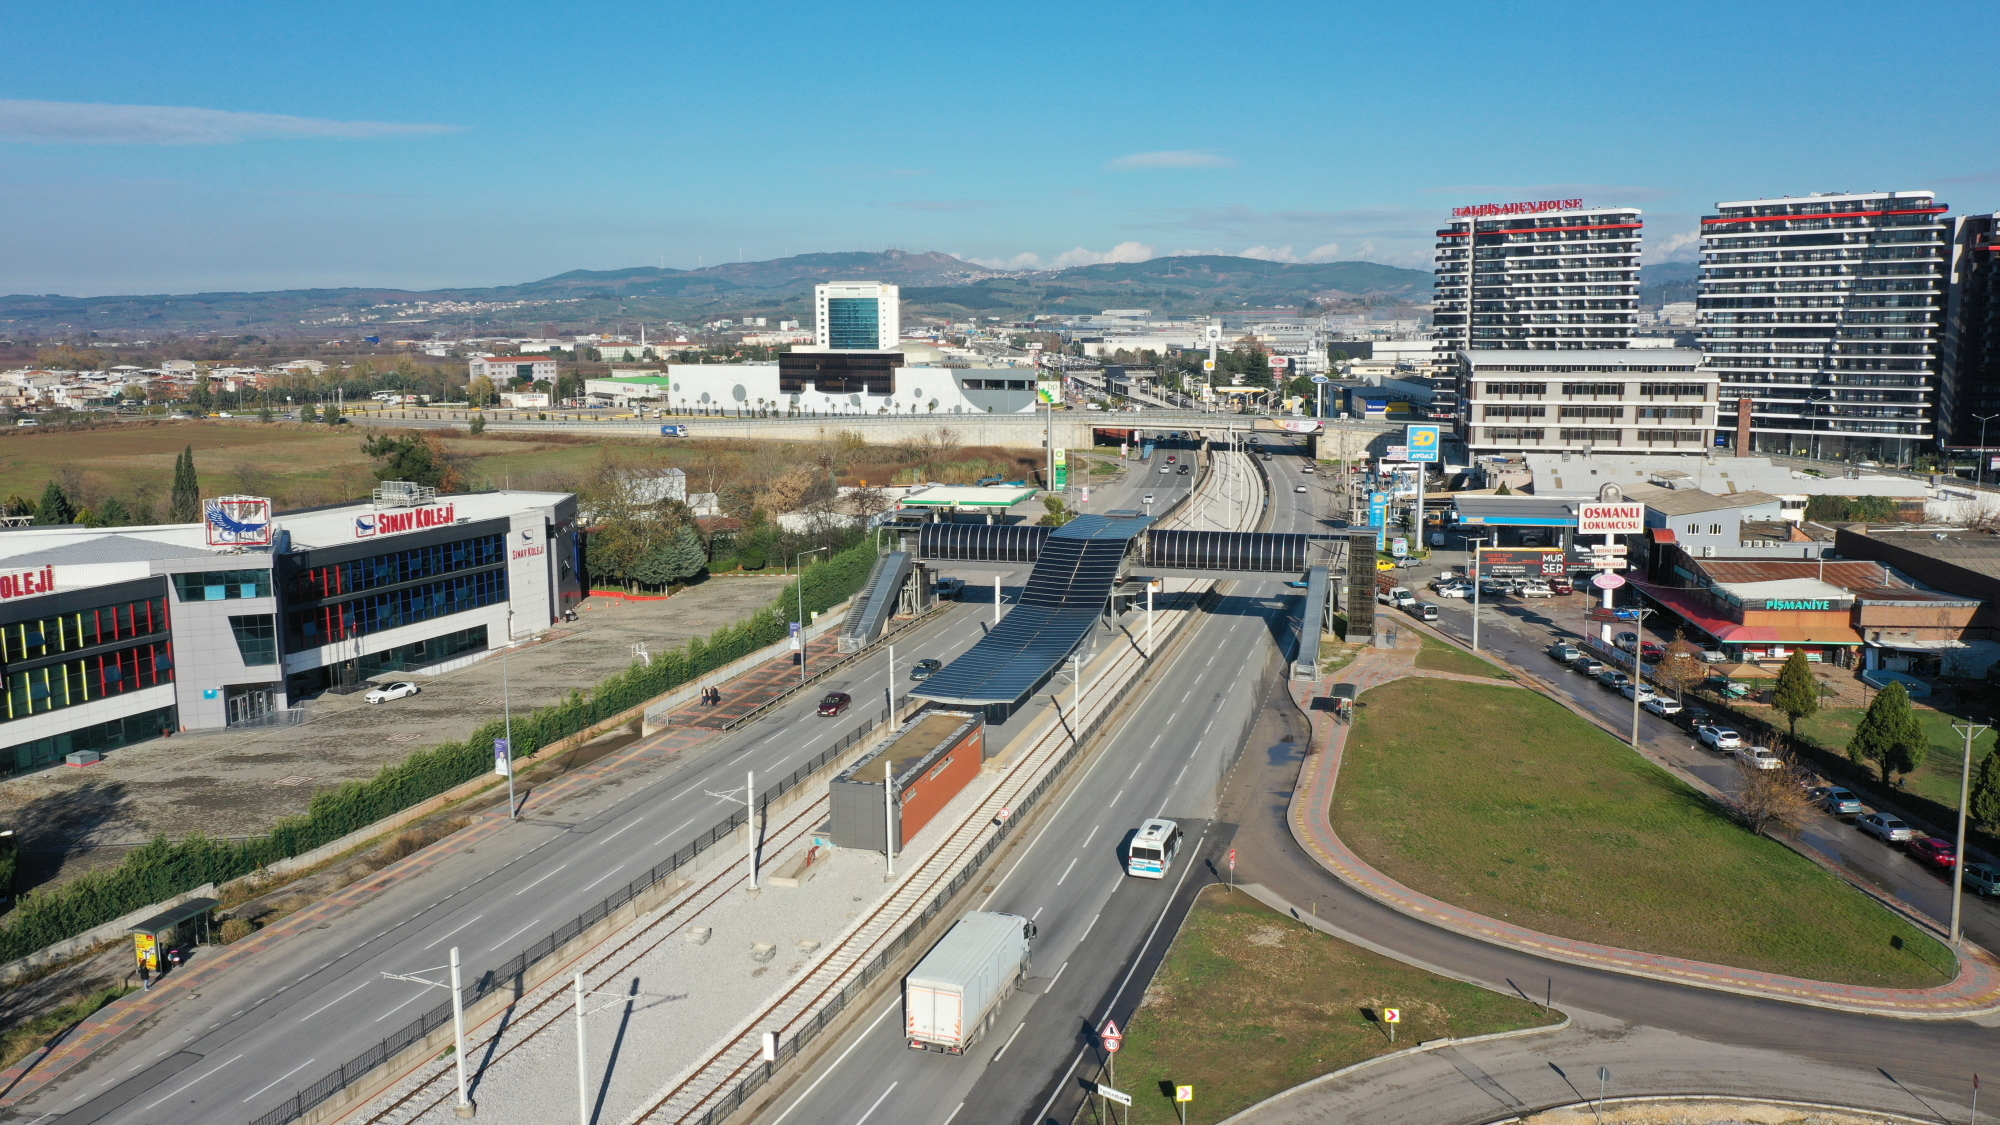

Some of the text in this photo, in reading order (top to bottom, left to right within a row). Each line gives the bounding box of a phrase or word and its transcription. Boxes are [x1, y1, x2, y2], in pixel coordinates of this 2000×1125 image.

[1540, 198, 1583, 212] HOUSE
[1047, 382, 1058, 391] bp
[379, 503, 455, 534] SINAV KOLEJİ
[1583, 507, 1640, 519] OSMANLI
[1583, 521, 1640, 530] LOKUMCUSU
[512, 543, 545, 560] SINAV KOLEJİ
[1542, 554, 1564, 563] MUR
[1542, 563, 1564, 573] SER
[1765, 598, 1830, 611] PİŞMANİYE
[1107, 1040, 1117, 1048] 50
